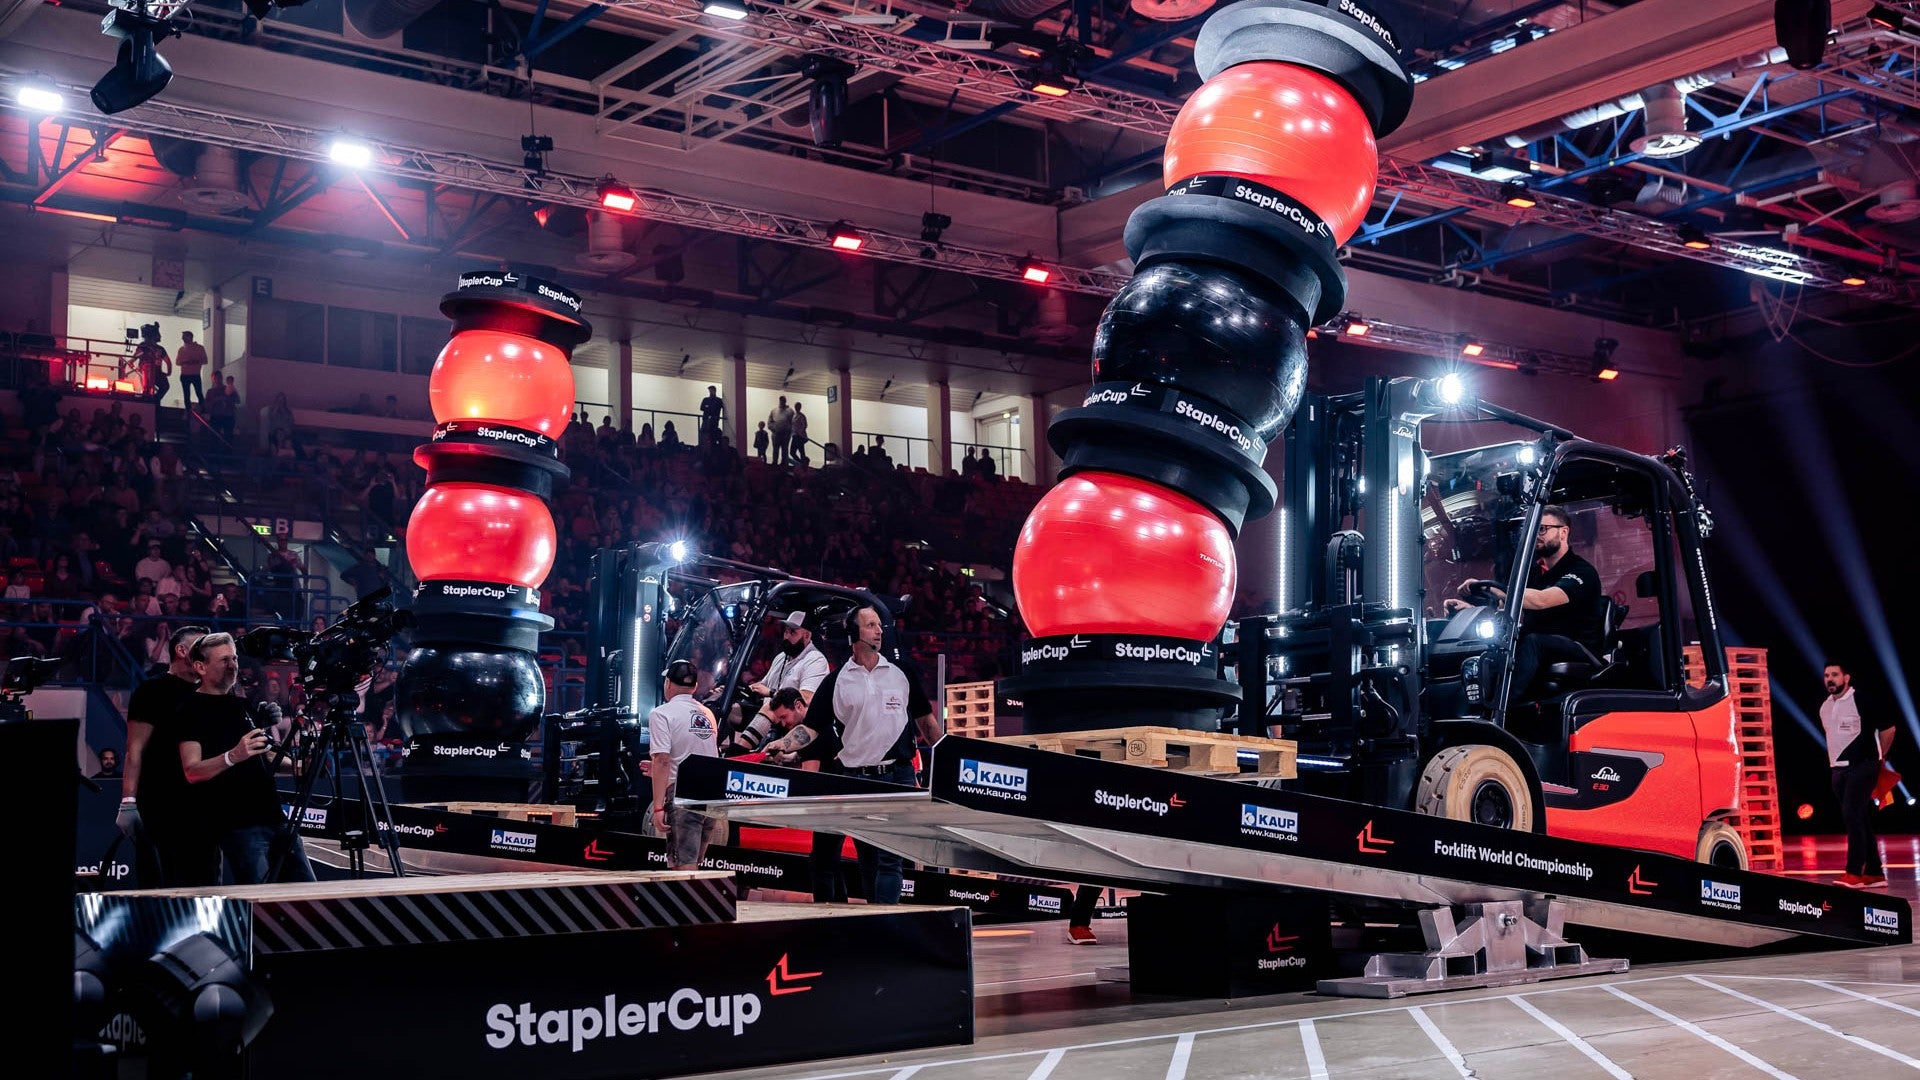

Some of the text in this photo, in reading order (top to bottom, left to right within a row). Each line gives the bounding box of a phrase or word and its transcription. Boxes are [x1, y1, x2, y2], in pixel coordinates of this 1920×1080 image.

[1339, 0, 1396, 49] StaplerC
[1235, 185, 1315, 233] StaplerCup
[460, 276, 503, 288] StaplerCup
[538, 285, 580, 312] StaplerCup
[1175, 400, 1251, 450] StaplerCup
[477, 427, 537, 447] StaplerCup
[275, 518, 289, 534] B
[442, 585, 506, 599] StaplerCup
[1115, 642, 1201, 666] StaplerCup
[433, 745, 497, 758] StaplerCup
[980, 770, 1025, 787] KAUP
[1590, 766, 1621, 782] Linde
[745, 780, 787, 795] KAUP
[958, 784, 1027, 801] www.kaup.de
[1094, 789, 1169, 816] StaplerCup
[378, 821, 435, 838] StplerCup
[1259, 814, 1296, 829] KAUP
[505, 836, 535, 845] KAUP
[1240, 827, 1298, 842] www.kaup.de
[490, 844, 536, 853] www.kaup.de
[647, 851, 668, 863] Fork
[715, 859, 784, 878] Championship
[1434, 840, 1594, 881] Forklift World Championship
[949, 889, 990, 903] StaplerCup
[1713, 887, 1739, 900] KAUP
[1038, 899, 1060, 907] KAUP
[1701, 899, 1742, 910] www.kaup.de
[1778, 899, 1823, 918] StaplerCup
[1874, 914, 1897, 925] KAUP
[1257, 956, 1306, 970] StaplerCup
[485, 988, 762, 1052] StaplerCup
